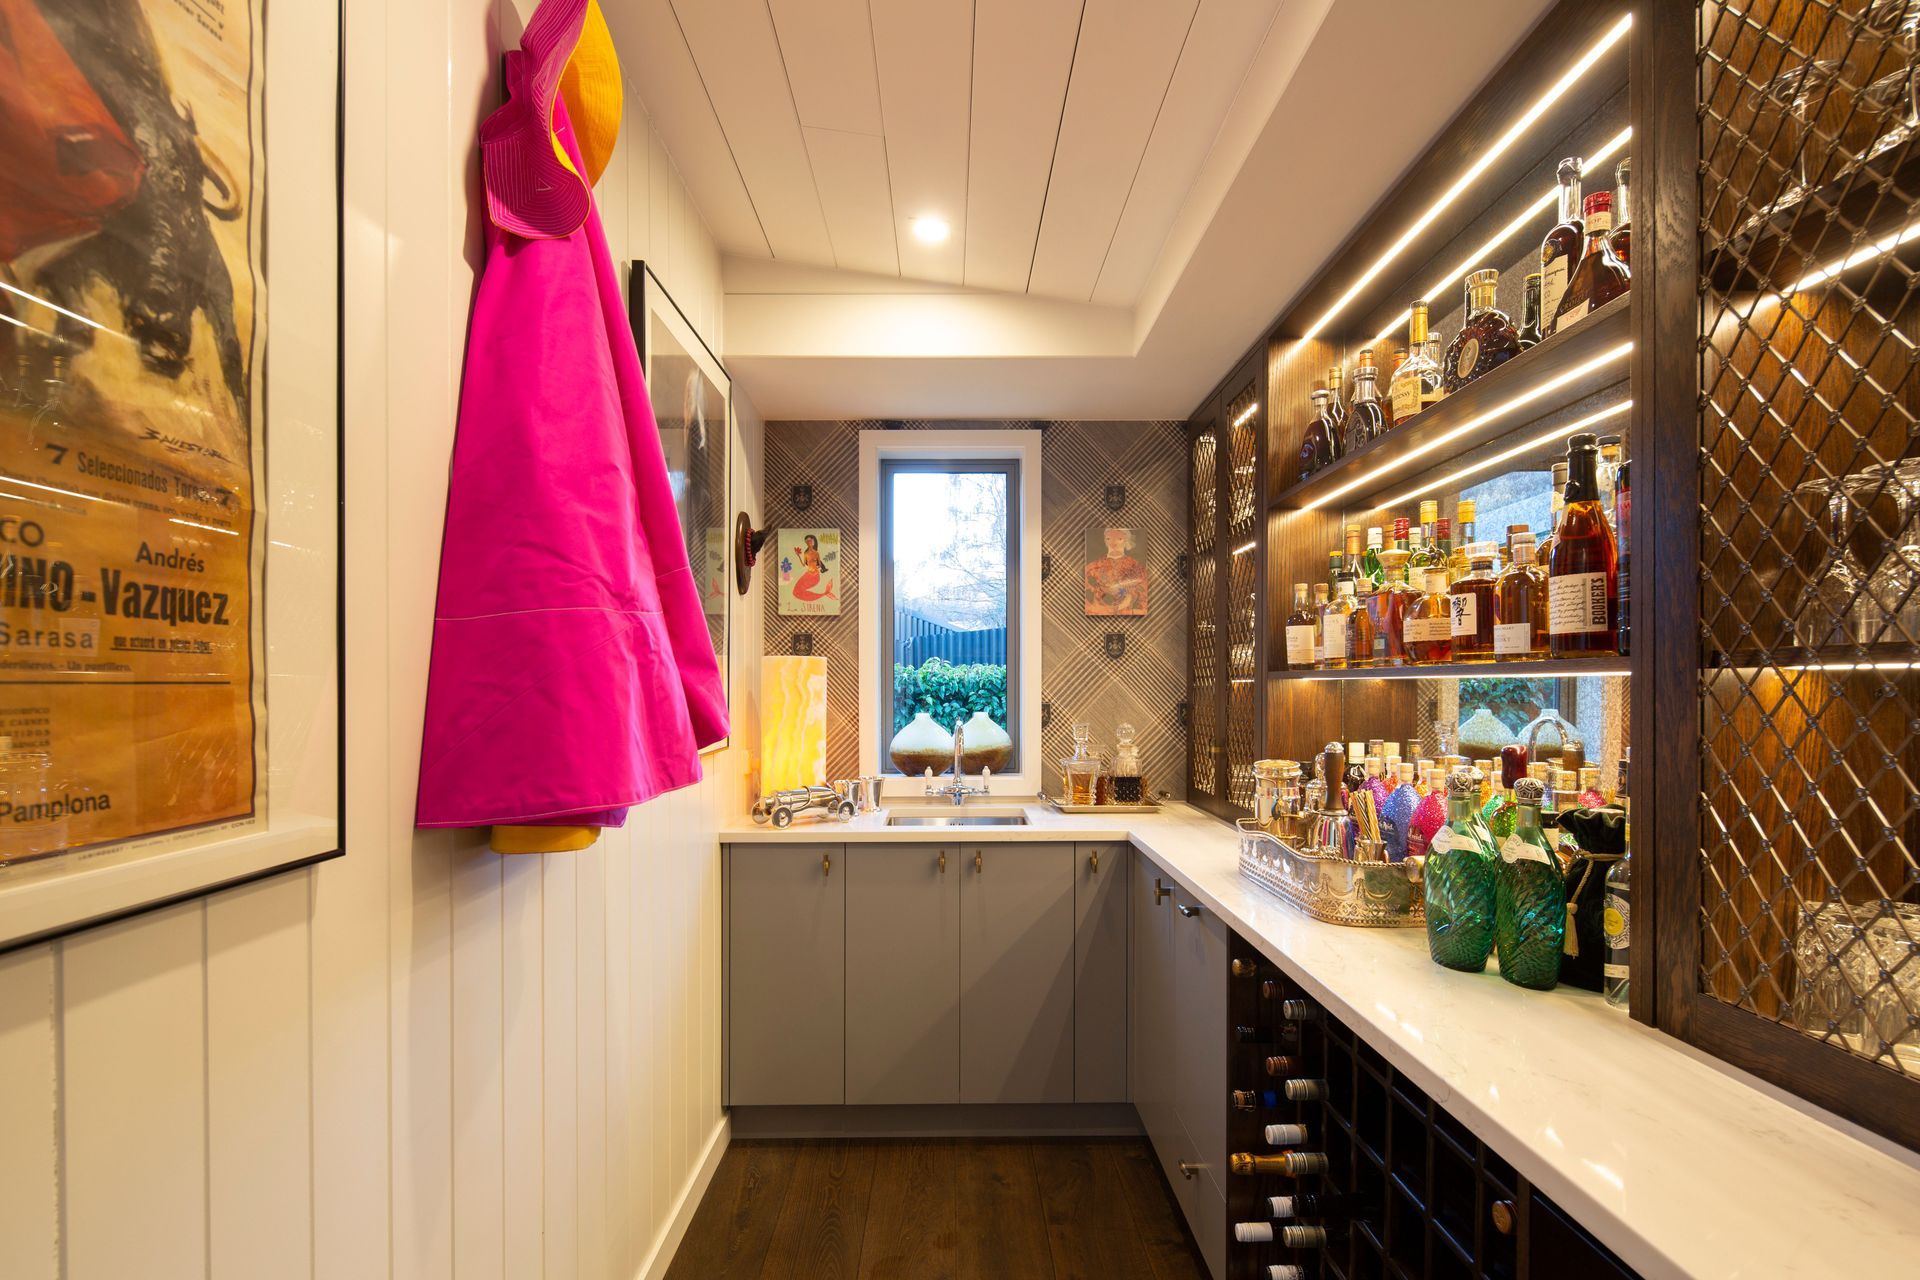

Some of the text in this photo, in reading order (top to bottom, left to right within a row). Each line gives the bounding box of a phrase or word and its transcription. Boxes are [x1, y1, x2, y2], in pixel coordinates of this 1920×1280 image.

[45, 444, 69, 465] 7
[77, 452, 168, 493] Seleccionados
[135, 542, 205, 573] Andrés
[0, 553, 74, 612] INO
[101, 568, 229, 626] Vazquez
[1591, 576, 1606, 625] BOOKER'S
[0, 793, 111, 823] Pamplona
